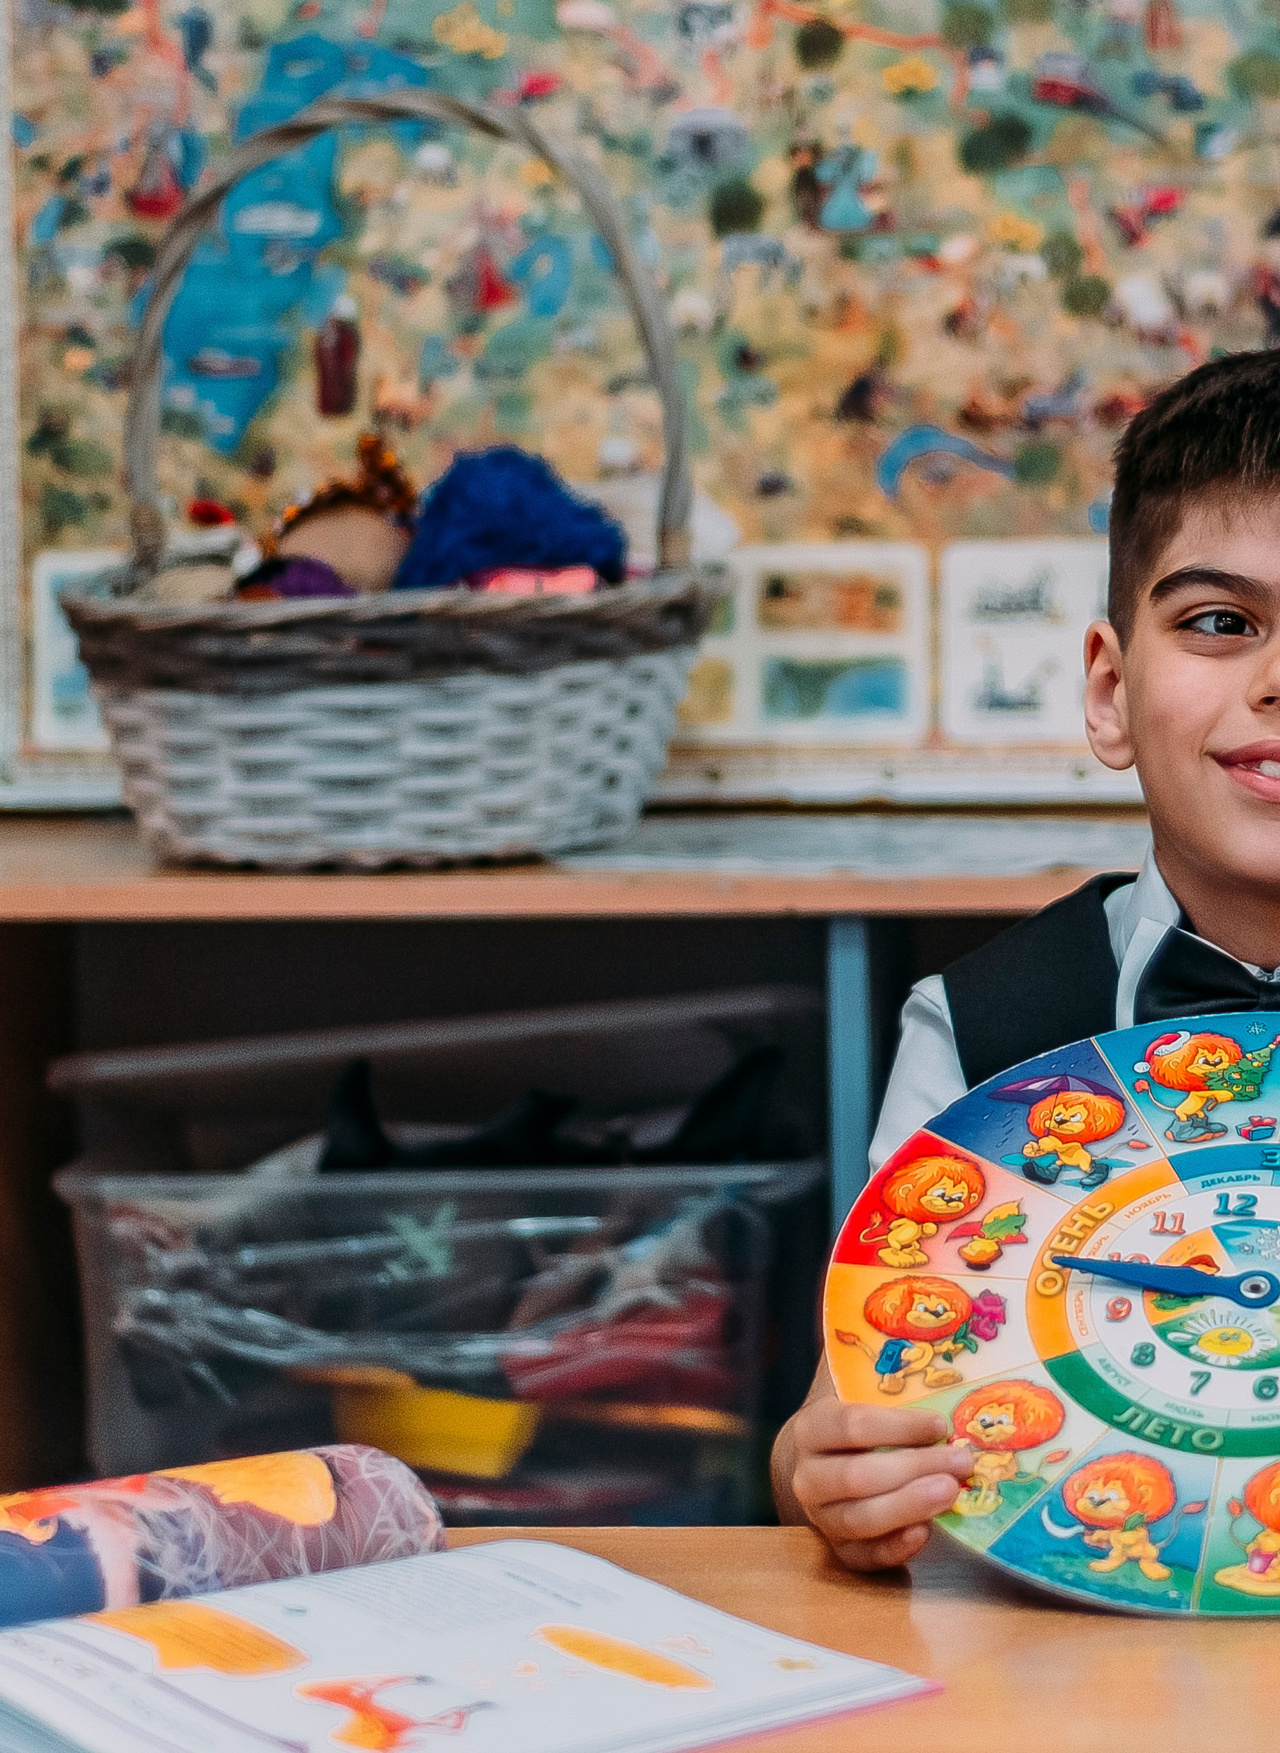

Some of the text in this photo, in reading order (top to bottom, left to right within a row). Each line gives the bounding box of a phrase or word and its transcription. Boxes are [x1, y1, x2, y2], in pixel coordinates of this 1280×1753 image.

[1200, 1173, 1261, 1189] ДЕКАБРЬ
[1124, 1192, 1172, 1218] НОЯБРЬ
[1213, 1192, 1258, 1217] 12
[1150, 1211, 1186, 1234] 11
[1106, 1296, 1132, 1321] 9
[1130, 1341, 1156, 1367] 8
[1189, 1370, 1211, 1395] 7
[1252, 1375, 1279, 1400] 6
[1112, 1406, 1224, 1450] ЛЕТО
